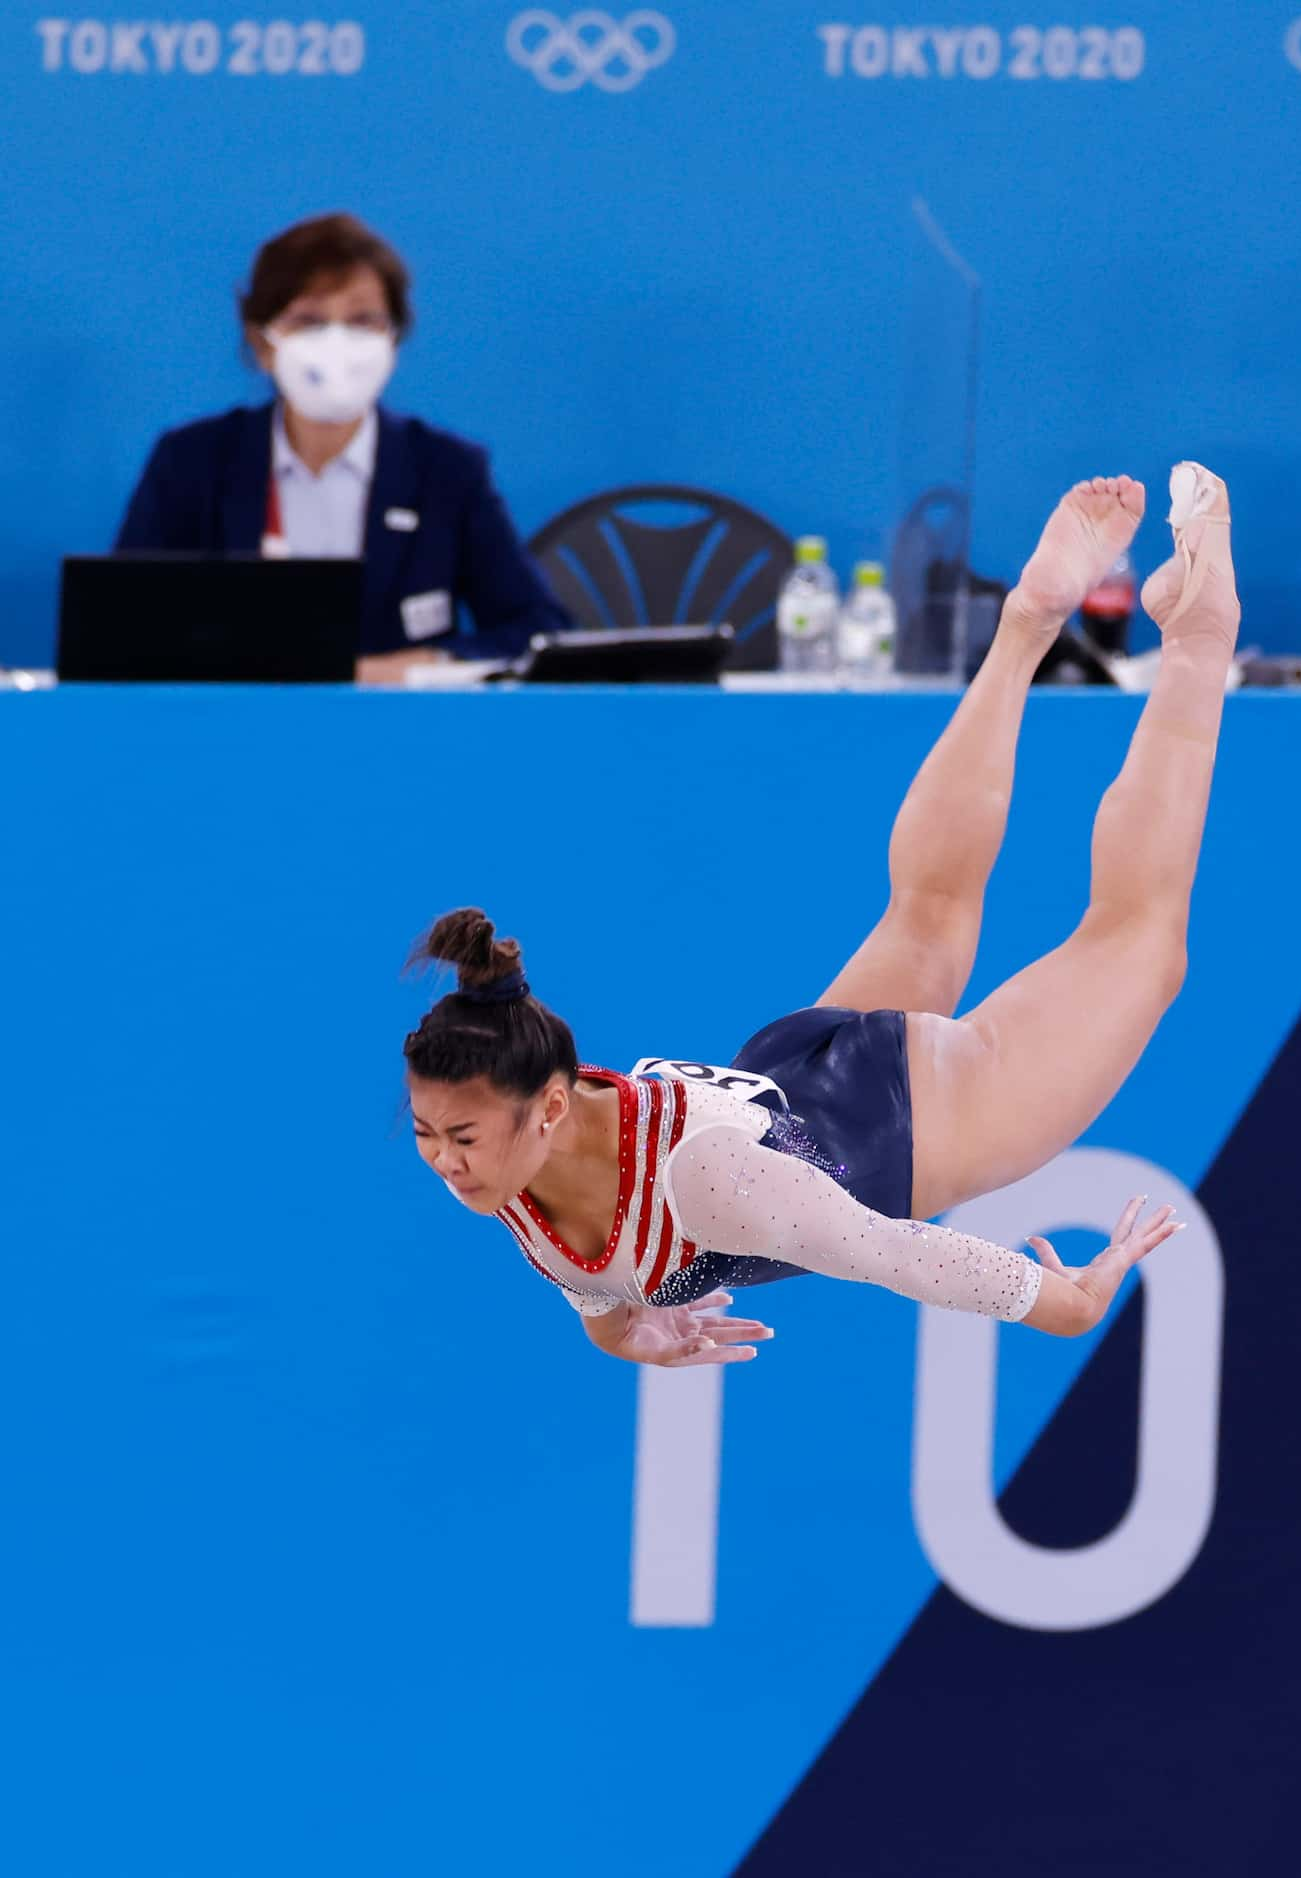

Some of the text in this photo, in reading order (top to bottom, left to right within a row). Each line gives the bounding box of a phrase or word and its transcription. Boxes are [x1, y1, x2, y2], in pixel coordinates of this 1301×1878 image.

[38, 18, 364, 76] TOKYO 2020
[820, 23, 1144, 81] TOKYO 2020
